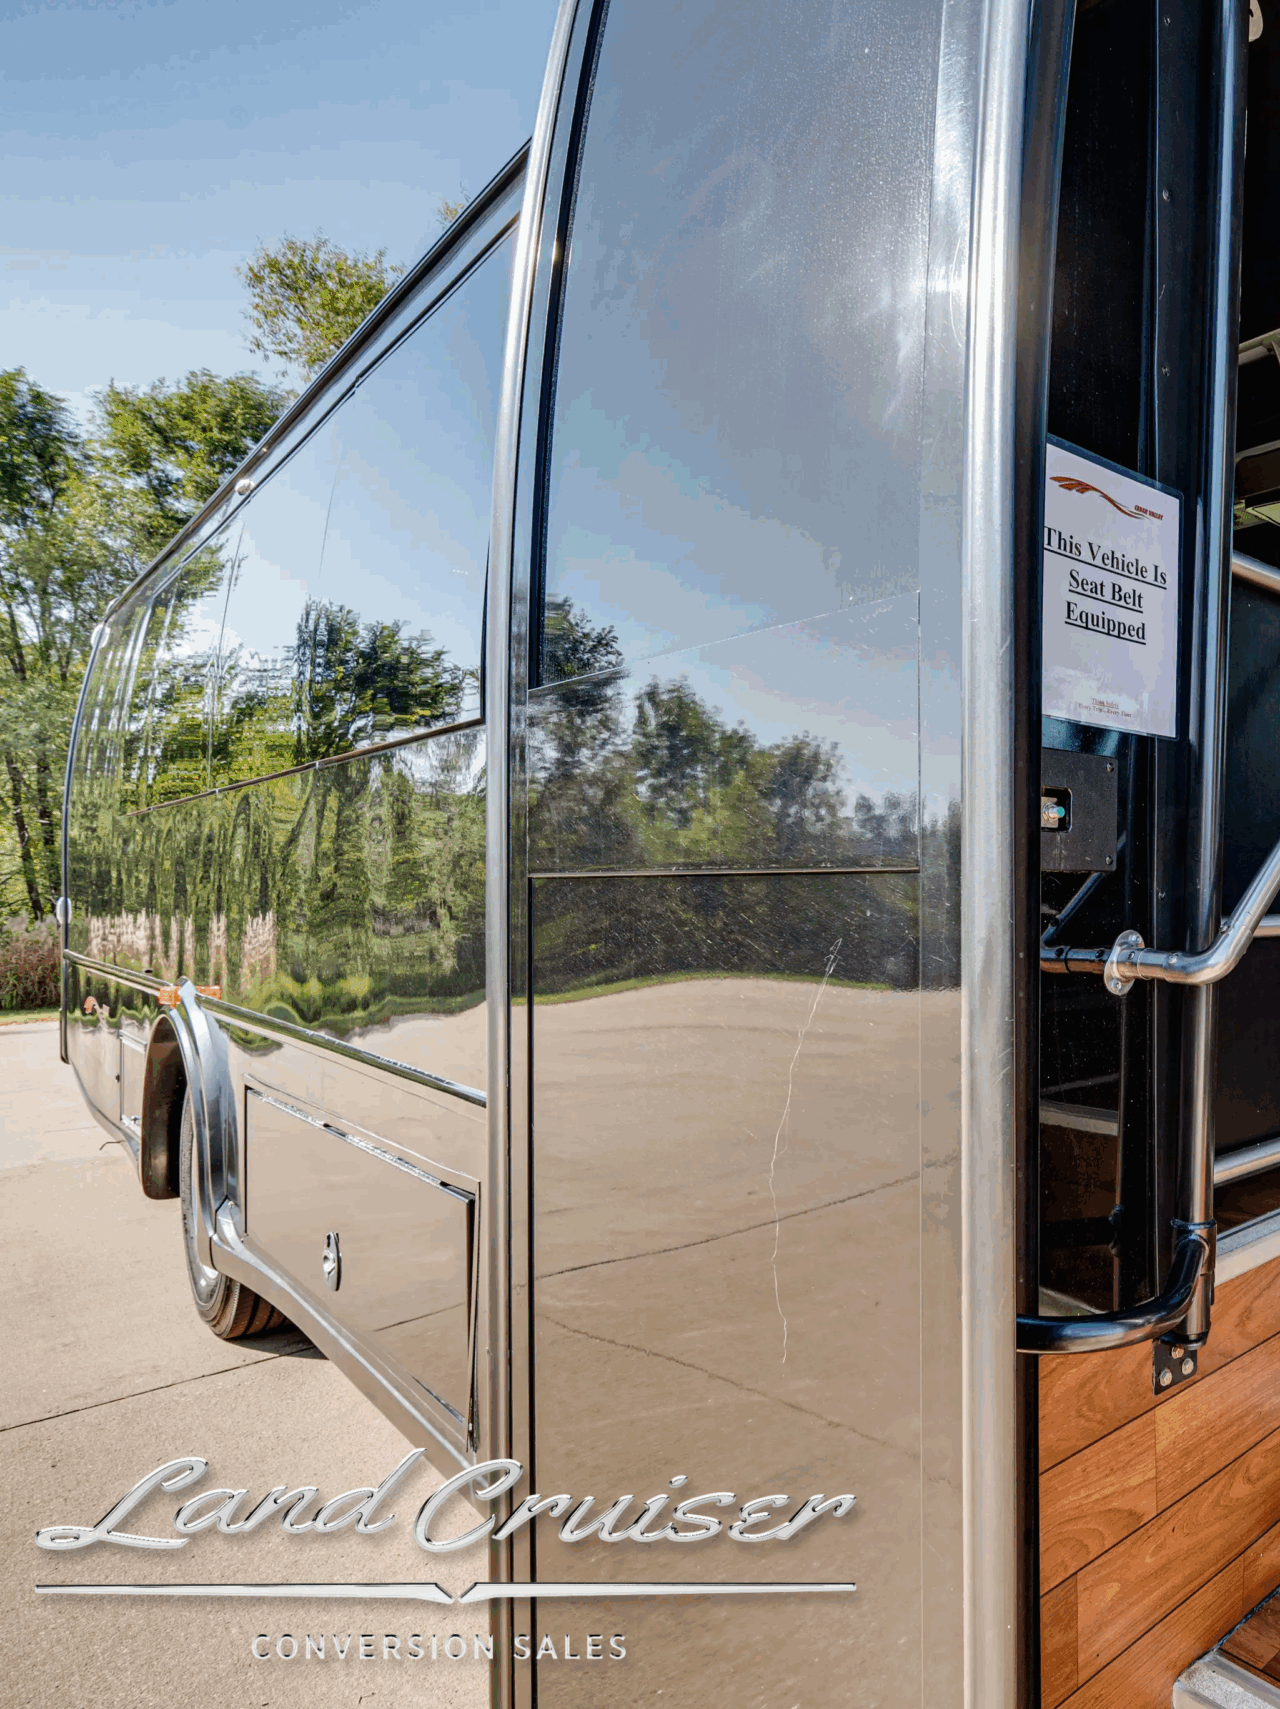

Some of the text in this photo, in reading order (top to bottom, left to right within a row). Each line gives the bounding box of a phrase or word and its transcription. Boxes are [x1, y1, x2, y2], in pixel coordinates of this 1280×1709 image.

[1044, 526, 1167, 585] This Vehicle Is
[1069, 569, 1144, 609] Seat Belt
[1065, 600, 1146, 641] Equipped
